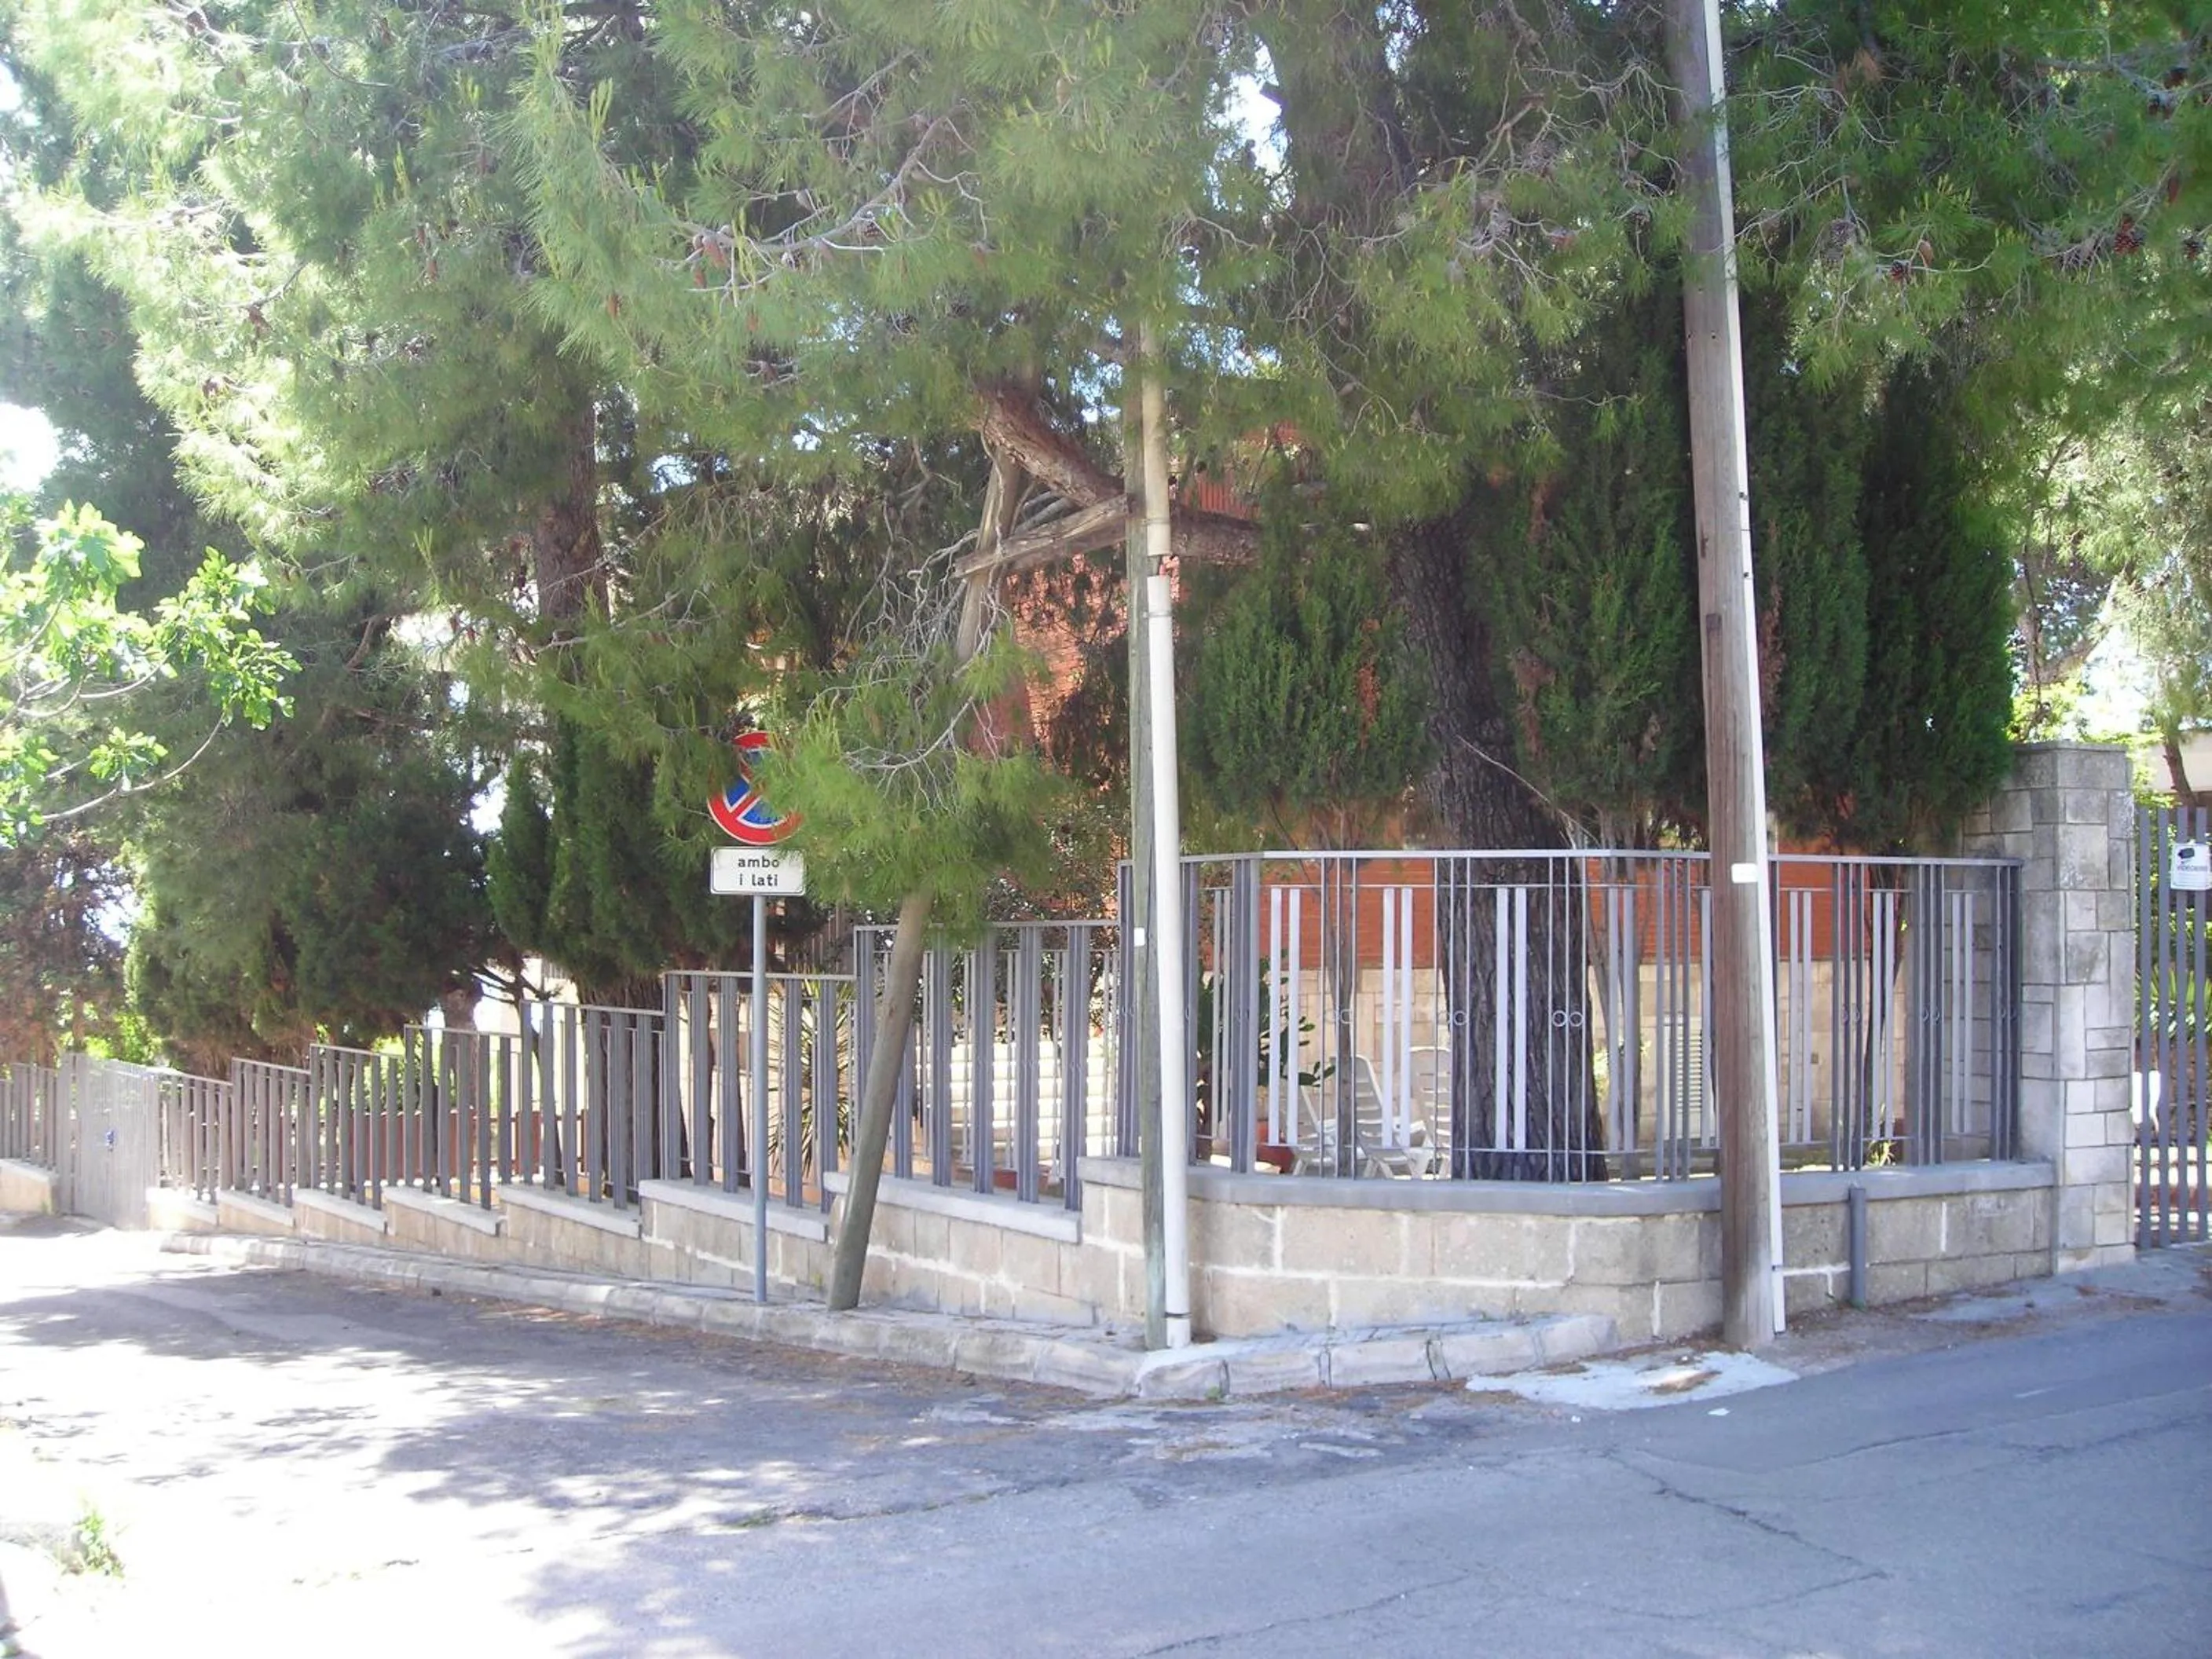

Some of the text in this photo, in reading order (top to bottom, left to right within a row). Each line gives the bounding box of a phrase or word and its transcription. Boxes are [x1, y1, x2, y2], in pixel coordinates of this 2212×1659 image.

[738, 855, 780, 868] ambo
[739, 873, 778, 887] i lati
